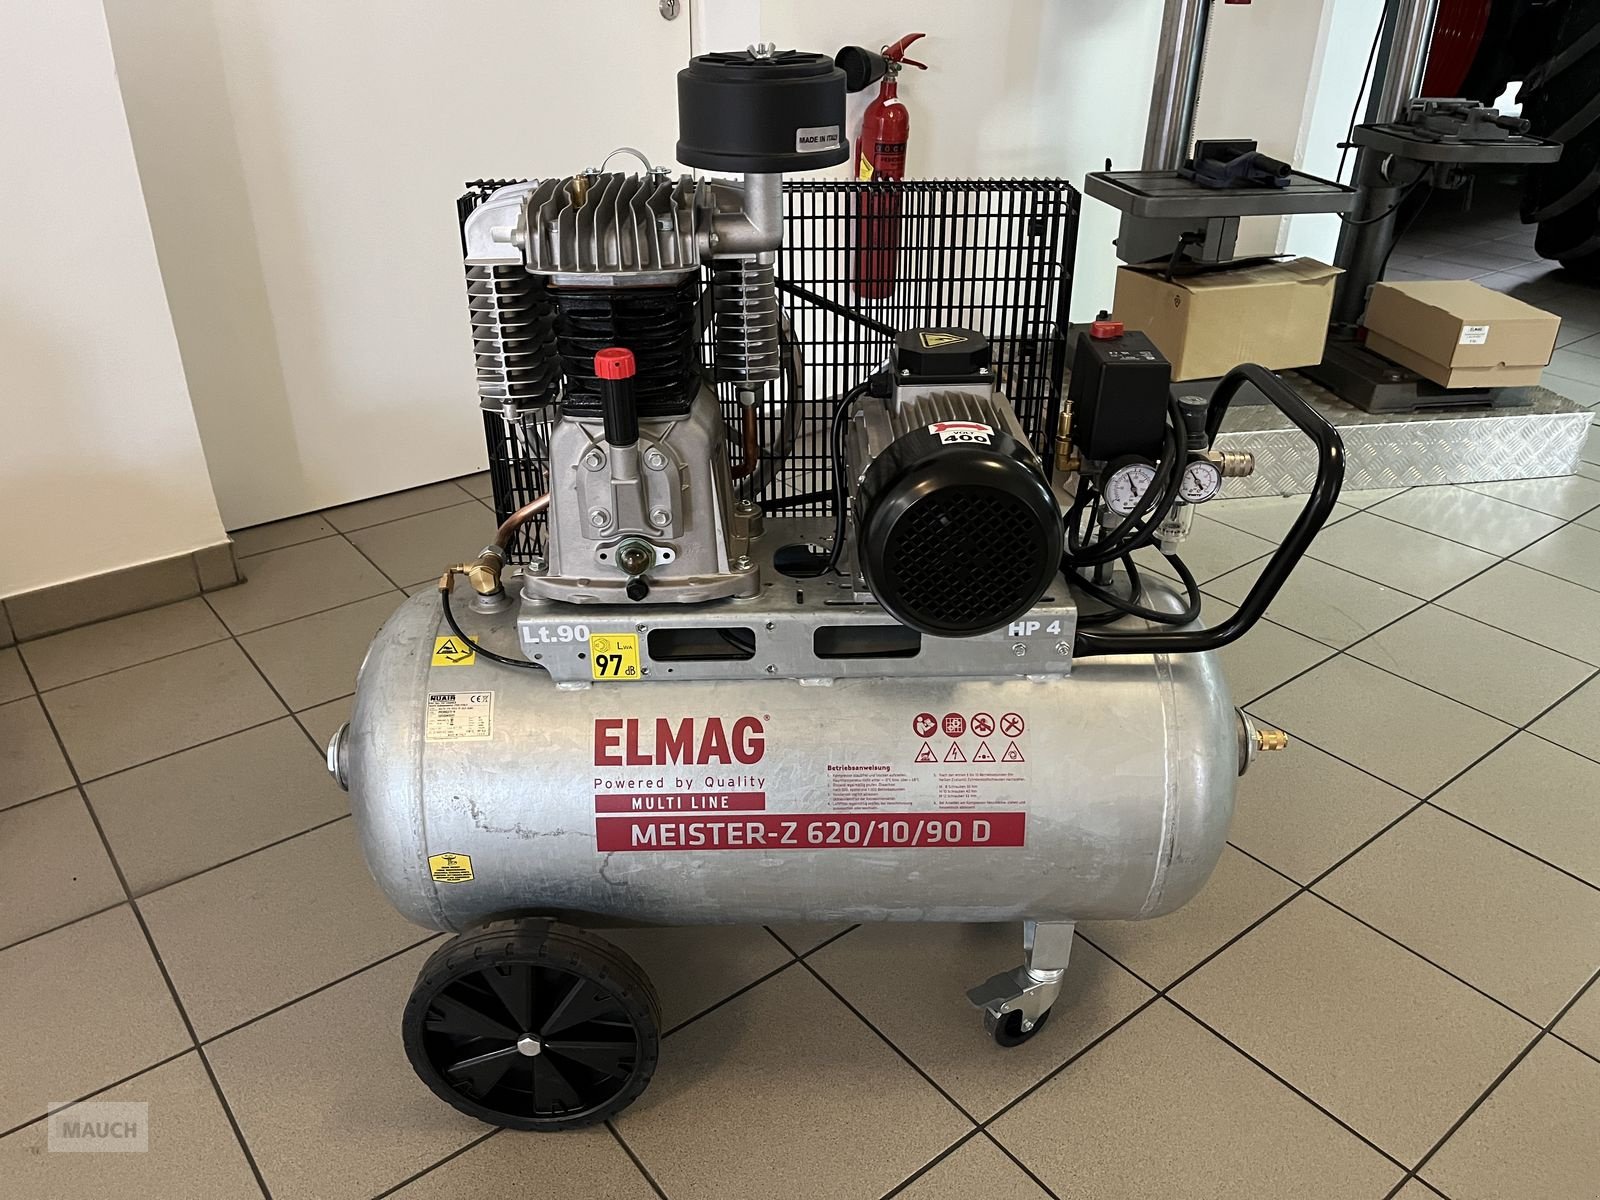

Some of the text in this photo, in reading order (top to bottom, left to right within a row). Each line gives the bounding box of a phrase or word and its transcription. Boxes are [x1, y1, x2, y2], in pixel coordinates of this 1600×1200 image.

[799, 136, 818, 144] MADE
[819, 135, 826, 143] IN
[944, 434, 987, 442] 400
[522, 624, 591, 644] Lt.90
[1008, 620, 1061, 637] HP 4
[595, 654, 623, 676] 97
[624, 665, 636, 676] dB
[594, 716, 765, 767] ELMAG
[594, 776, 766, 791] Powered by Quality
[631, 795, 730, 810] MULTI LINE
[631, 819, 991, 847] MEISTER-Z 620/10/90 D
